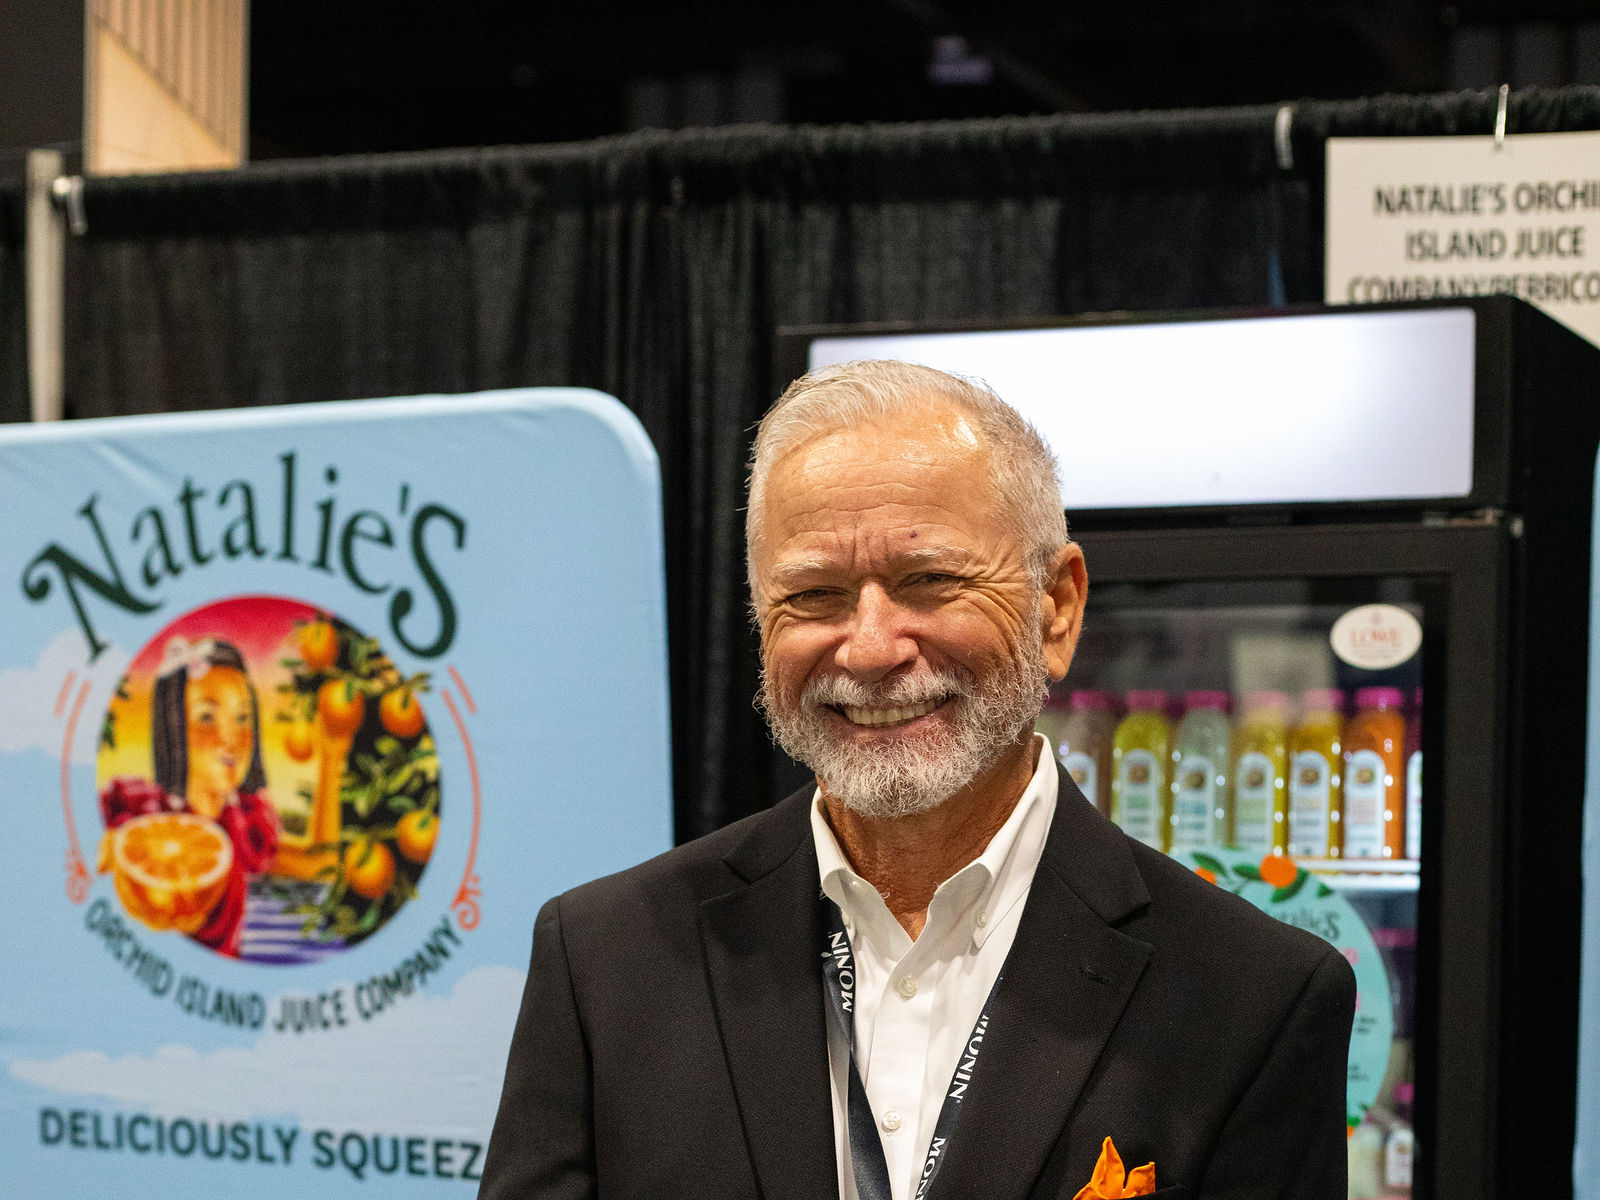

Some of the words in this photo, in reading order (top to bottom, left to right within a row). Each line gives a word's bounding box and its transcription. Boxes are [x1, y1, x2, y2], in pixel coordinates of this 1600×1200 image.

[1374, 183, 1507, 215] NATALIE'S
[1514, 179, 1600, 212] ORCHI
[1405, 229, 1507, 260] ISLAND
[1514, 226, 1585, 258] JUICE
[85, 897, 173, 997] ORCHID
[176, 972, 266, 1031] ISLAND
[273, 988, 346, 1033] JUICE
[354, 916, 462, 1020] COMPANY
[828, 931, 855, 1012] MONIN
[948, 1014, 990, 1100] MONIN
[39, 1106, 299, 1165] DELICIOUSLY
[312, 1130, 483, 1180] SQUEEZ
